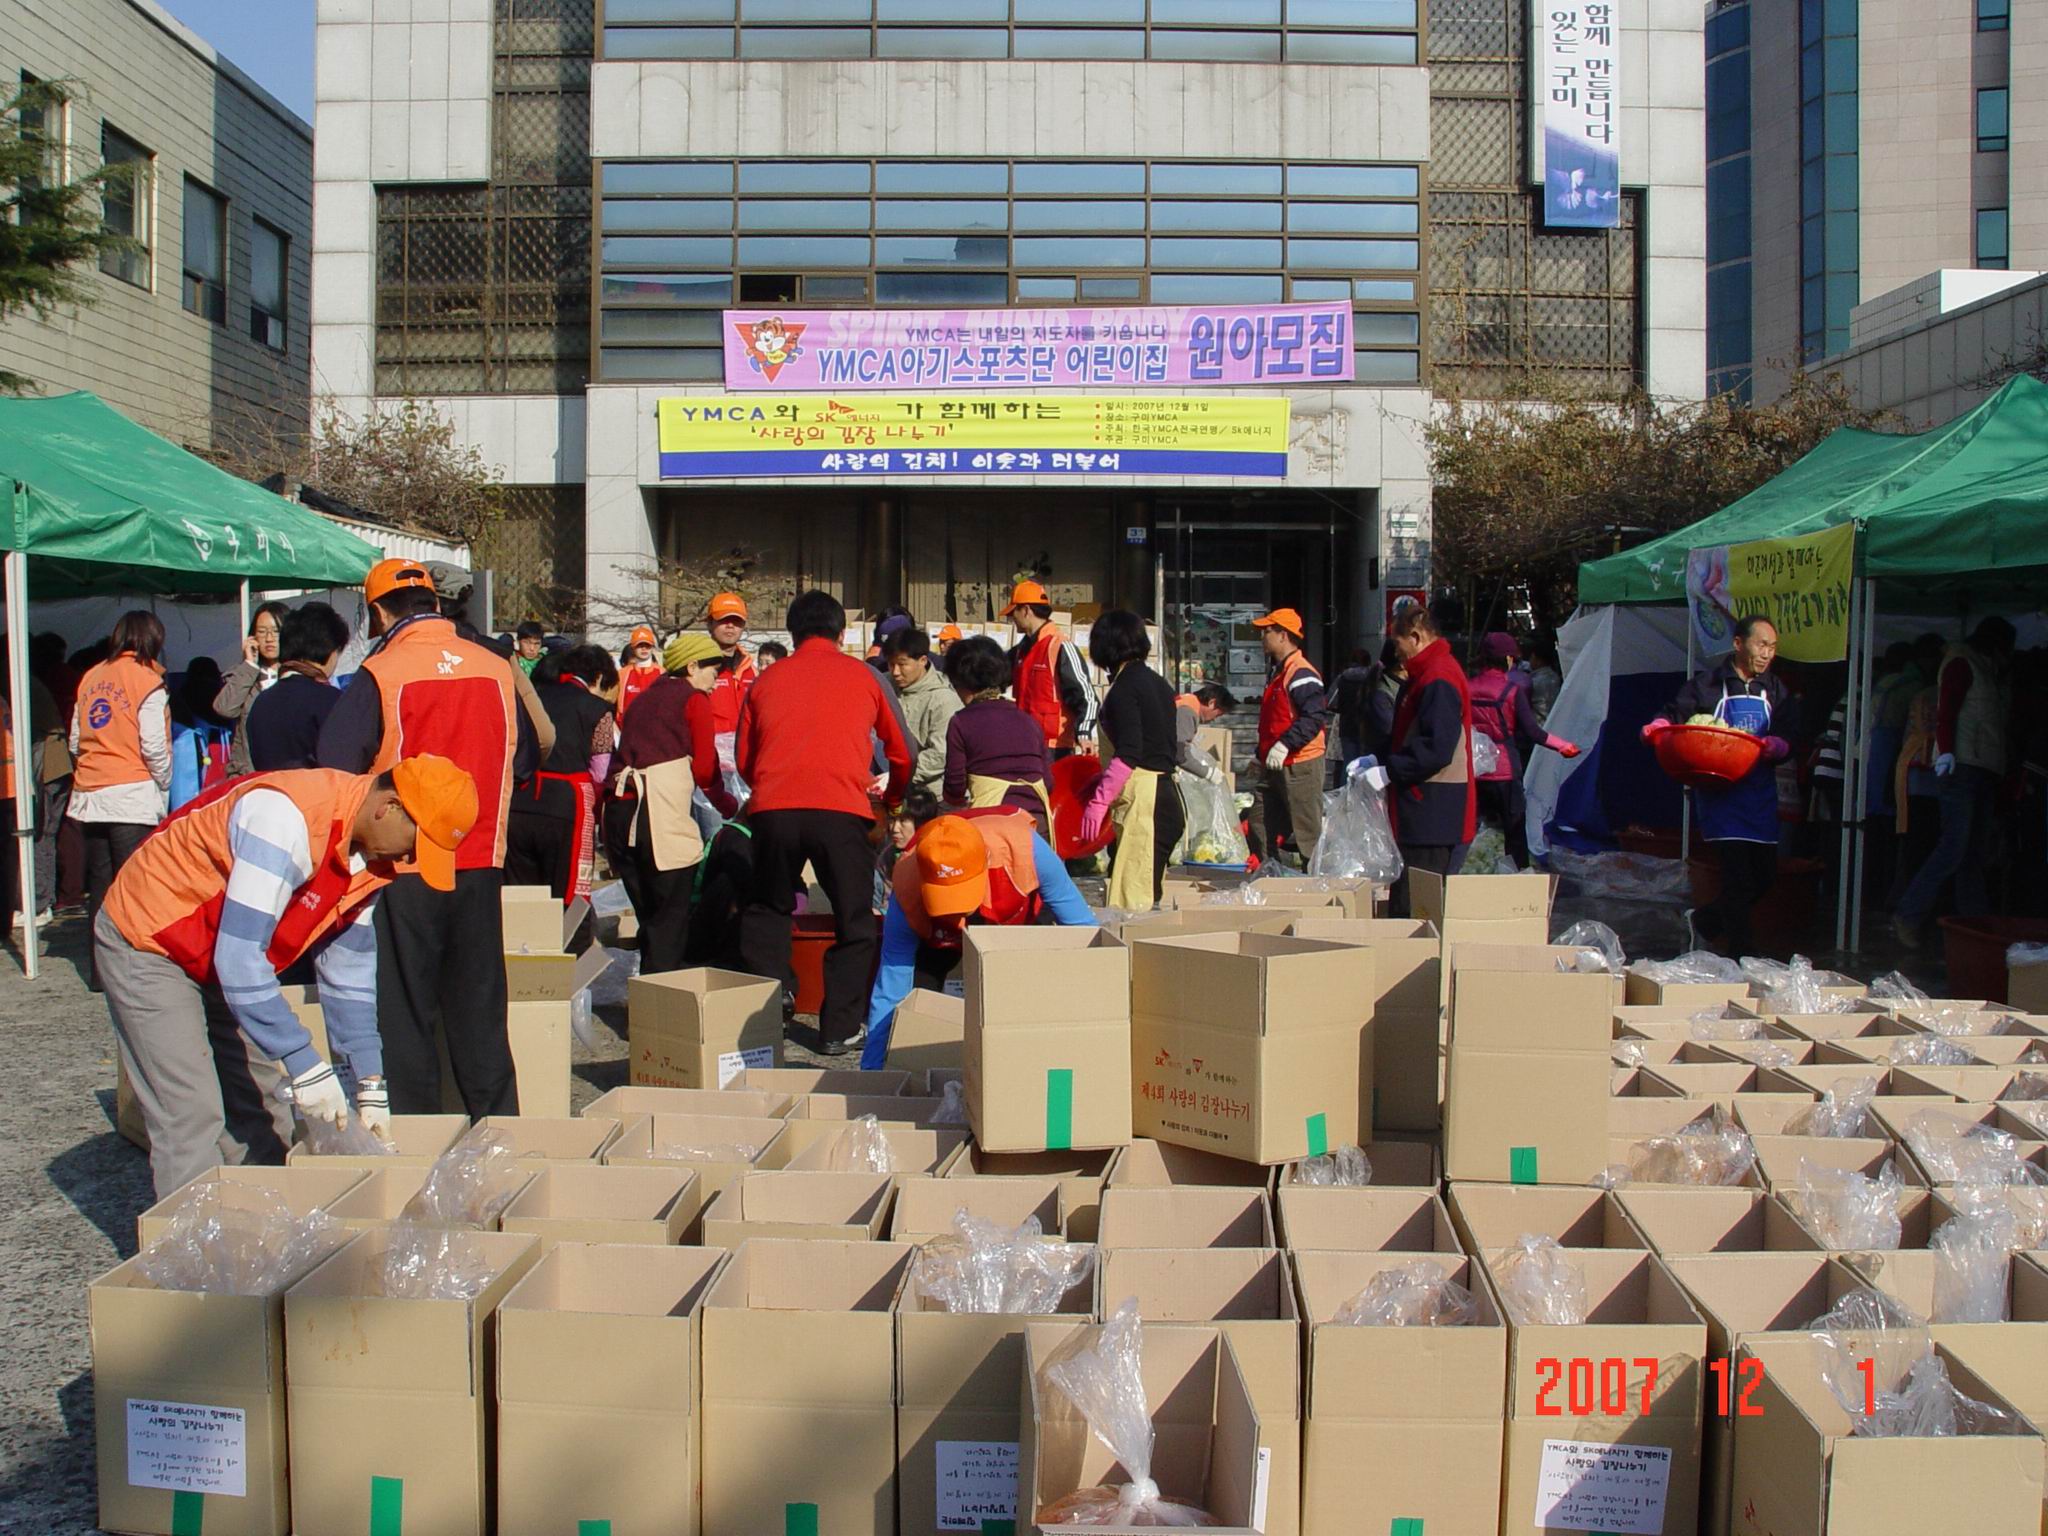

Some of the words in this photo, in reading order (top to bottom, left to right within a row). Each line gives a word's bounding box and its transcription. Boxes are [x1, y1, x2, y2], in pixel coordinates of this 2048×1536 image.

[1551, 11, 1579, 54] 있는
[1584, 4, 1613, 46] 함께
[1552, 65, 1579, 108] 구미
[1585, 59, 1614, 144] 만듭니다
[905, 327, 971, 343] YMCA는
[979, 326, 1025, 342] 내일의
[1033, 325, 1095, 342] 지도자를
[1103, 324, 1167, 341] 키웁니다
[1066, 344, 1168, 383] 어린이집
[1188, 313, 1346, 379] 원아모집
[1132, 413, 1178, 422] 구미YMCA
[1132, 435, 1179, 445] 구미YMCA
[821, 453, 889, 471] 사랑의
[972, 452, 1041, 470] 이웃과
[1052, 452, 1120, 471] 더불어
[437, 661, 454, 674] SK
[1169, 1087, 1197, 1111] 사랑의
[1200, 1093, 1250, 1122] 김장나누기
